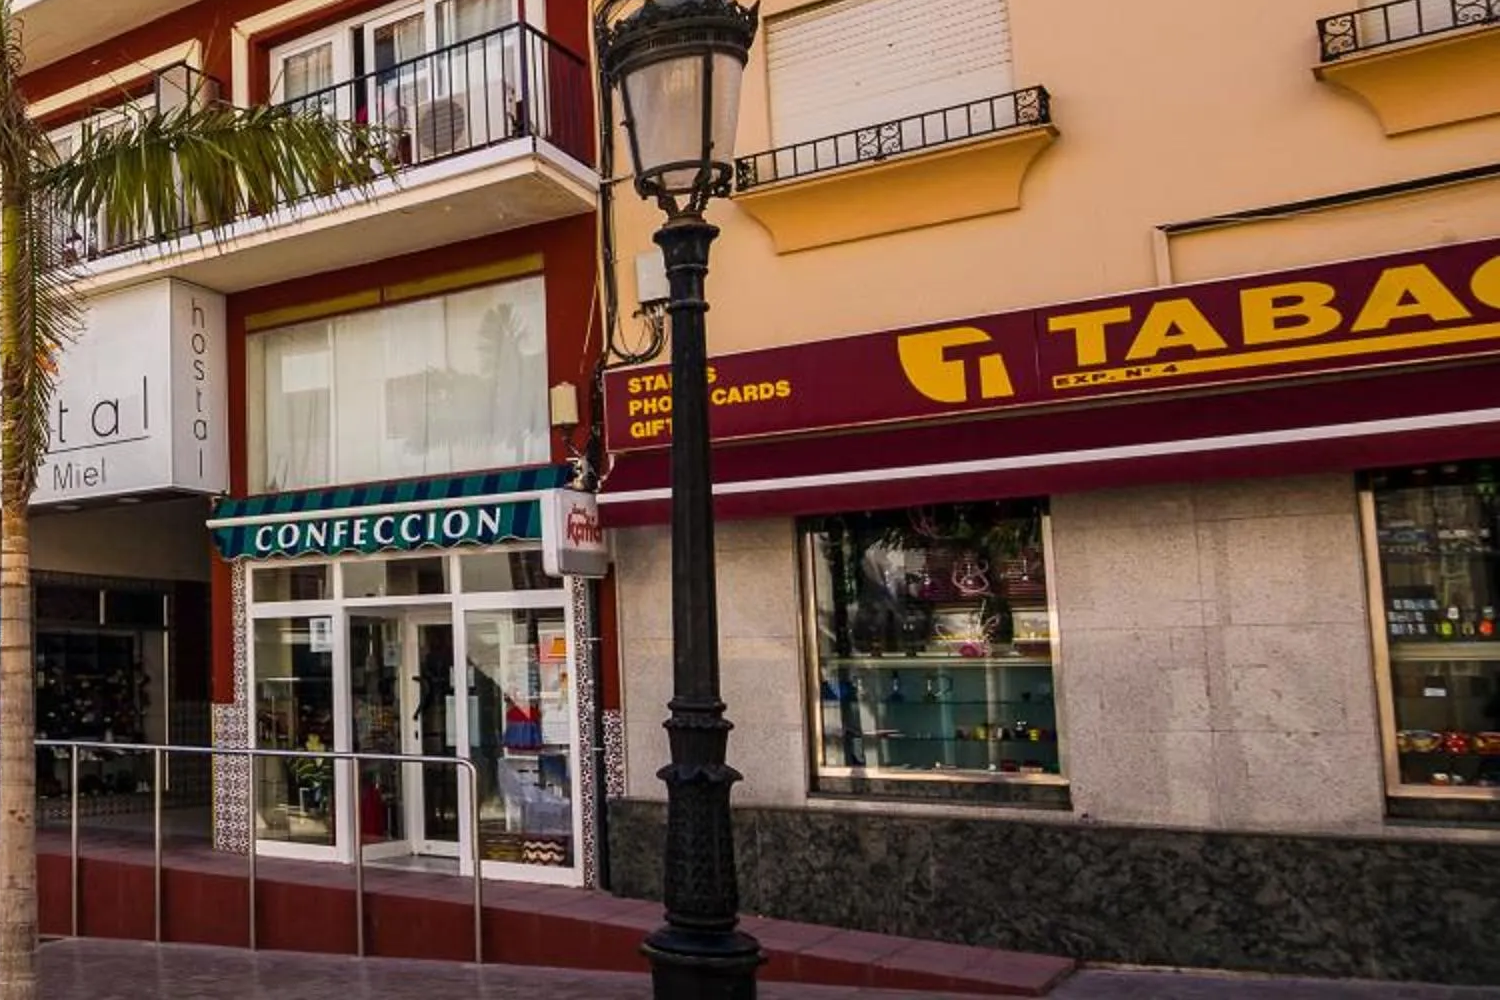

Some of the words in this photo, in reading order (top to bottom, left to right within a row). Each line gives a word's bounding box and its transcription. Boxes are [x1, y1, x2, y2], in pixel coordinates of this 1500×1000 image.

[1048, 253, 1500, 367] TABA
[1054, 372, 1117, 386] EXP.
[1162, 363, 1178, 374] 4
[710, 379, 792, 406] CARDS
[52, 456, 108, 490] Miel
[254, 506, 502, 551] CONFECCION
